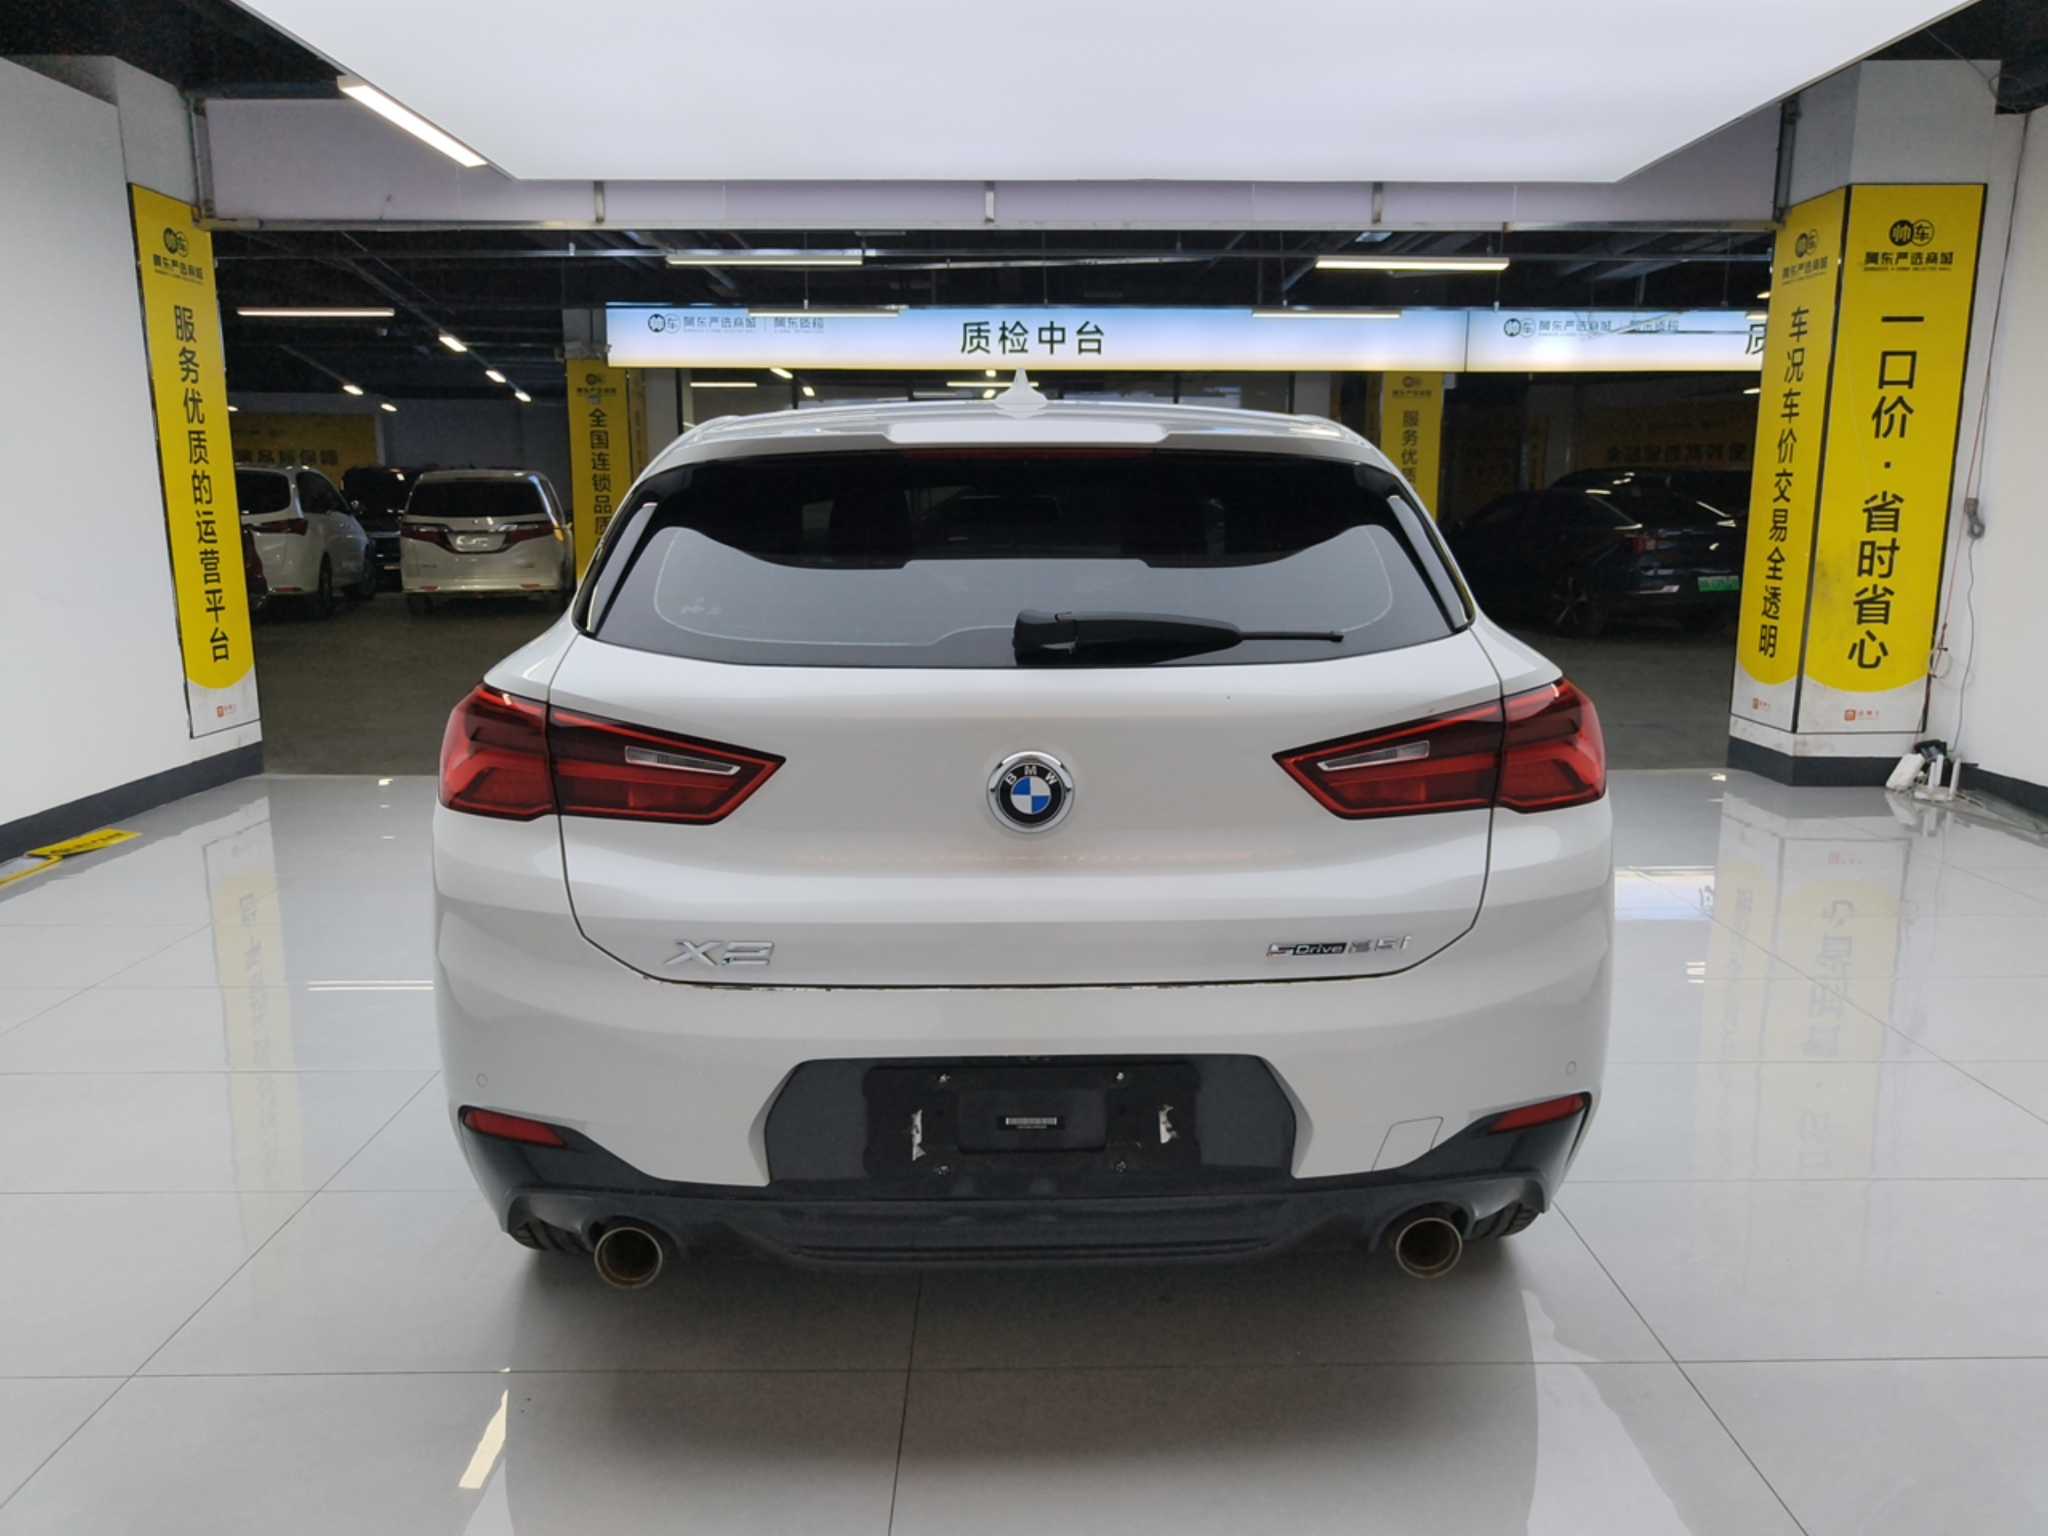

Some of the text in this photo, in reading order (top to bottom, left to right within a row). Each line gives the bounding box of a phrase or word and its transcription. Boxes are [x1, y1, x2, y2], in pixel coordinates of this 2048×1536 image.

[960, 320, 1106, 356] 质检中台
[173, 304, 230, 663] 服务优质的运营平台
[1758, 306, 1810, 659] 车况车价交易全透明
[1847, 315, 1925, 671] 一口价·省时省心
[1006, 765, 1058, 785] BMW
[663, 939, 775, 966] X2
